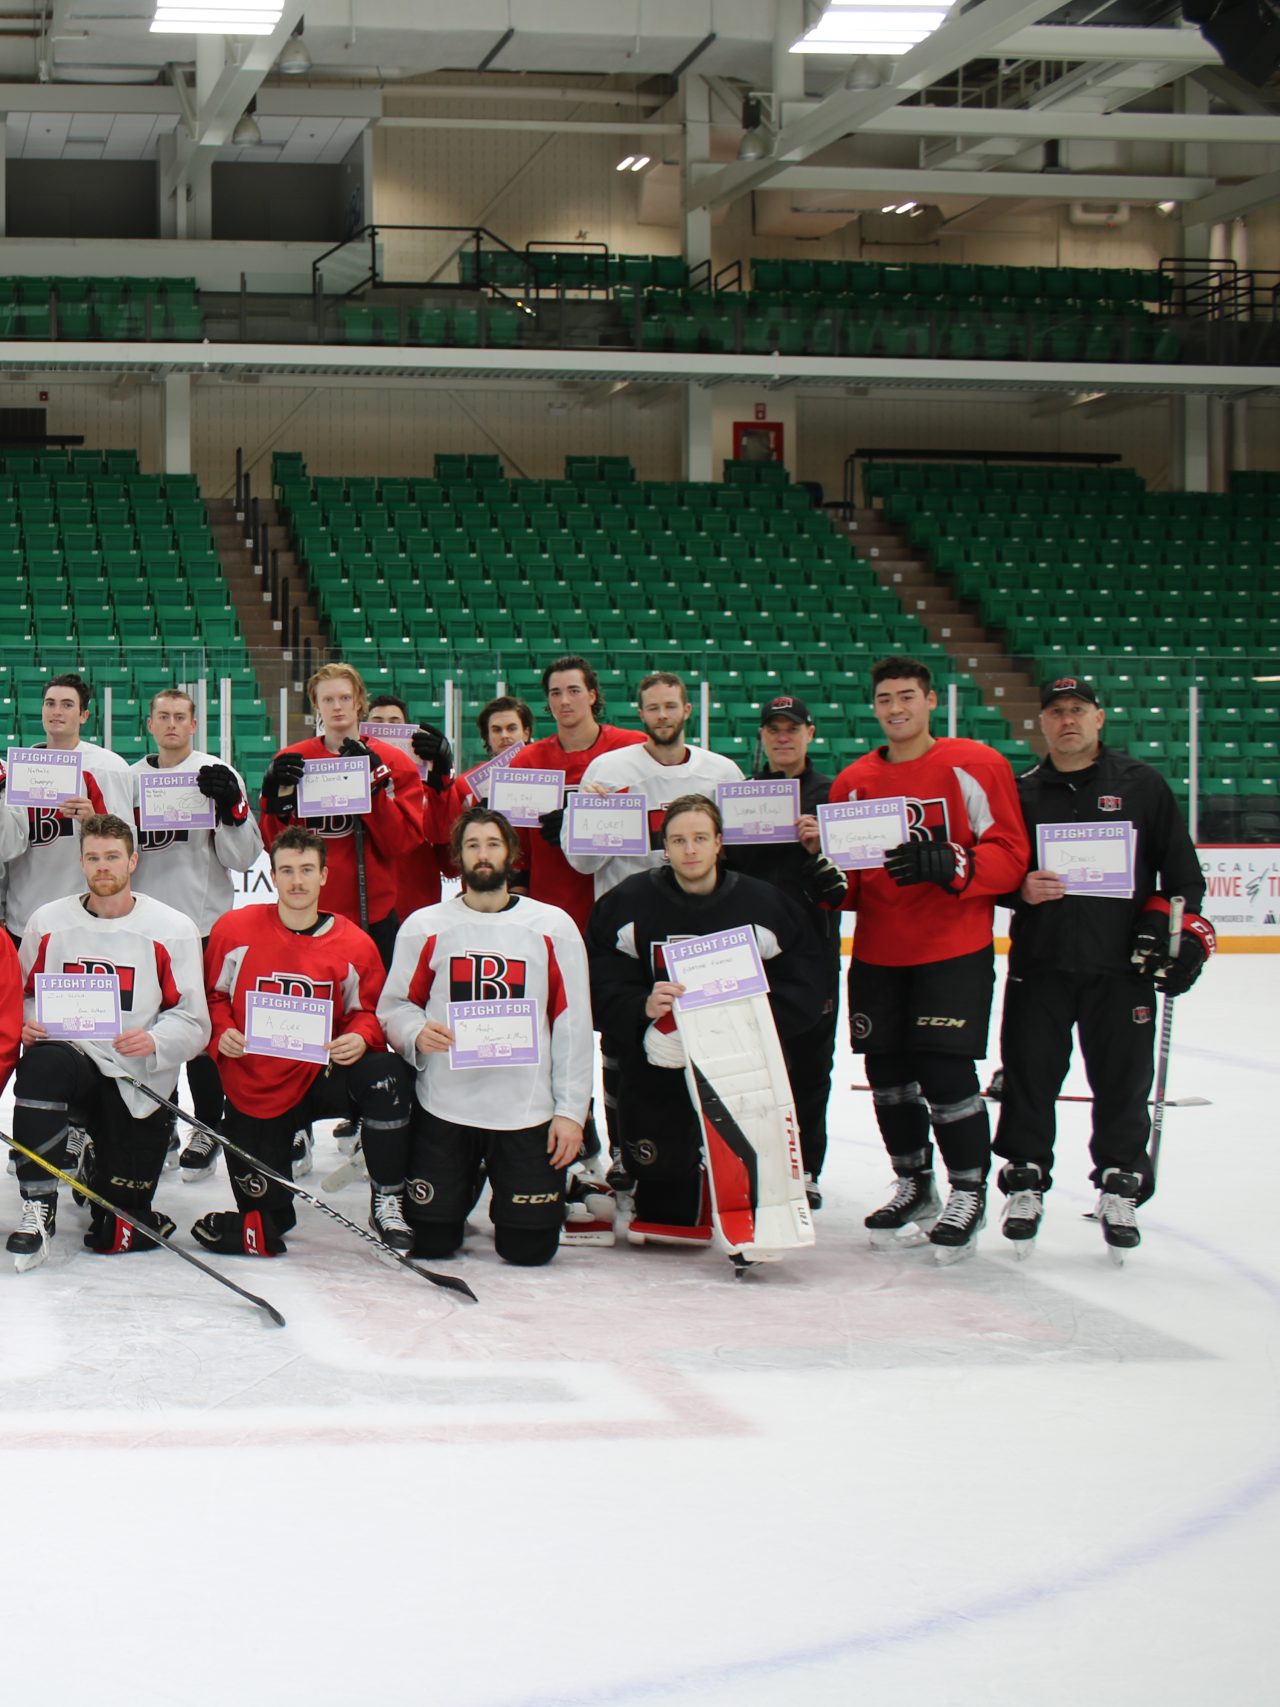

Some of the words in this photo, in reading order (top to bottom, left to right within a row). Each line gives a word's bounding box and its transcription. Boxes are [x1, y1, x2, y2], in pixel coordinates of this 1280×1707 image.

[364, 726, 369, 734] I
[371, 727, 402, 736] FIGHT
[13, 752, 18, 760] I
[21, 752, 54, 762] FIGHT
[56, 754, 77, 764] FOR
[309, 762, 341, 772] FIGHT
[343, 760, 364, 770] FOR
[144, 777, 149, 786] I
[152, 776, 184, 786] FIGHT
[495, 772, 500, 780] I
[503, 772, 536, 782] FIGHT
[538, 774, 559, 783] FOR
[721, 786, 727, 796] I
[730, 785, 767, 795] FIGHT
[769, 784, 792, 794] FOR
[573, 797, 579, 807] I
[582, 797, 617, 807] FIGHT
[619, 798, 641, 807] FOR
[824, 810, 830, 819] I
[833, 805, 871, 818] FIGHT
[874, 802, 899, 814] FOR
[31, 807, 61, 848] B
[1044, 830, 1050, 839] I
[1054, 828, 1095, 839] FIGHT
[1098, 827, 1124, 837] FOR
[1205, 876, 1242, 896] VIVE
[670, 949, 677, 960] I
[680, 938, 717, 957] FIGHT
[721, 932, 747, 946] FOR
[465, 951, 511, 1001] B
[41, 978, 47, 988] I
[50, 978, 86, 988] FIGHT
[90, 979, 112, 989] FOR
[252, 996, 257, 1005] I
[262, 997, 298, 1009] FIGHT
[302, 1002, 326, 1013] FOR
[453, 1007, 459, 1017] I
[463, 1004, 502, 1016] FIGHT
[506, 1004, 530, 1014] FOR
[266, 1015, 274, 1029] A
[916, 1016, 966, 1029] CCM
[785, 1110, 801, 1180] TRUE
[511, 1192, 559, 1205] CCM
